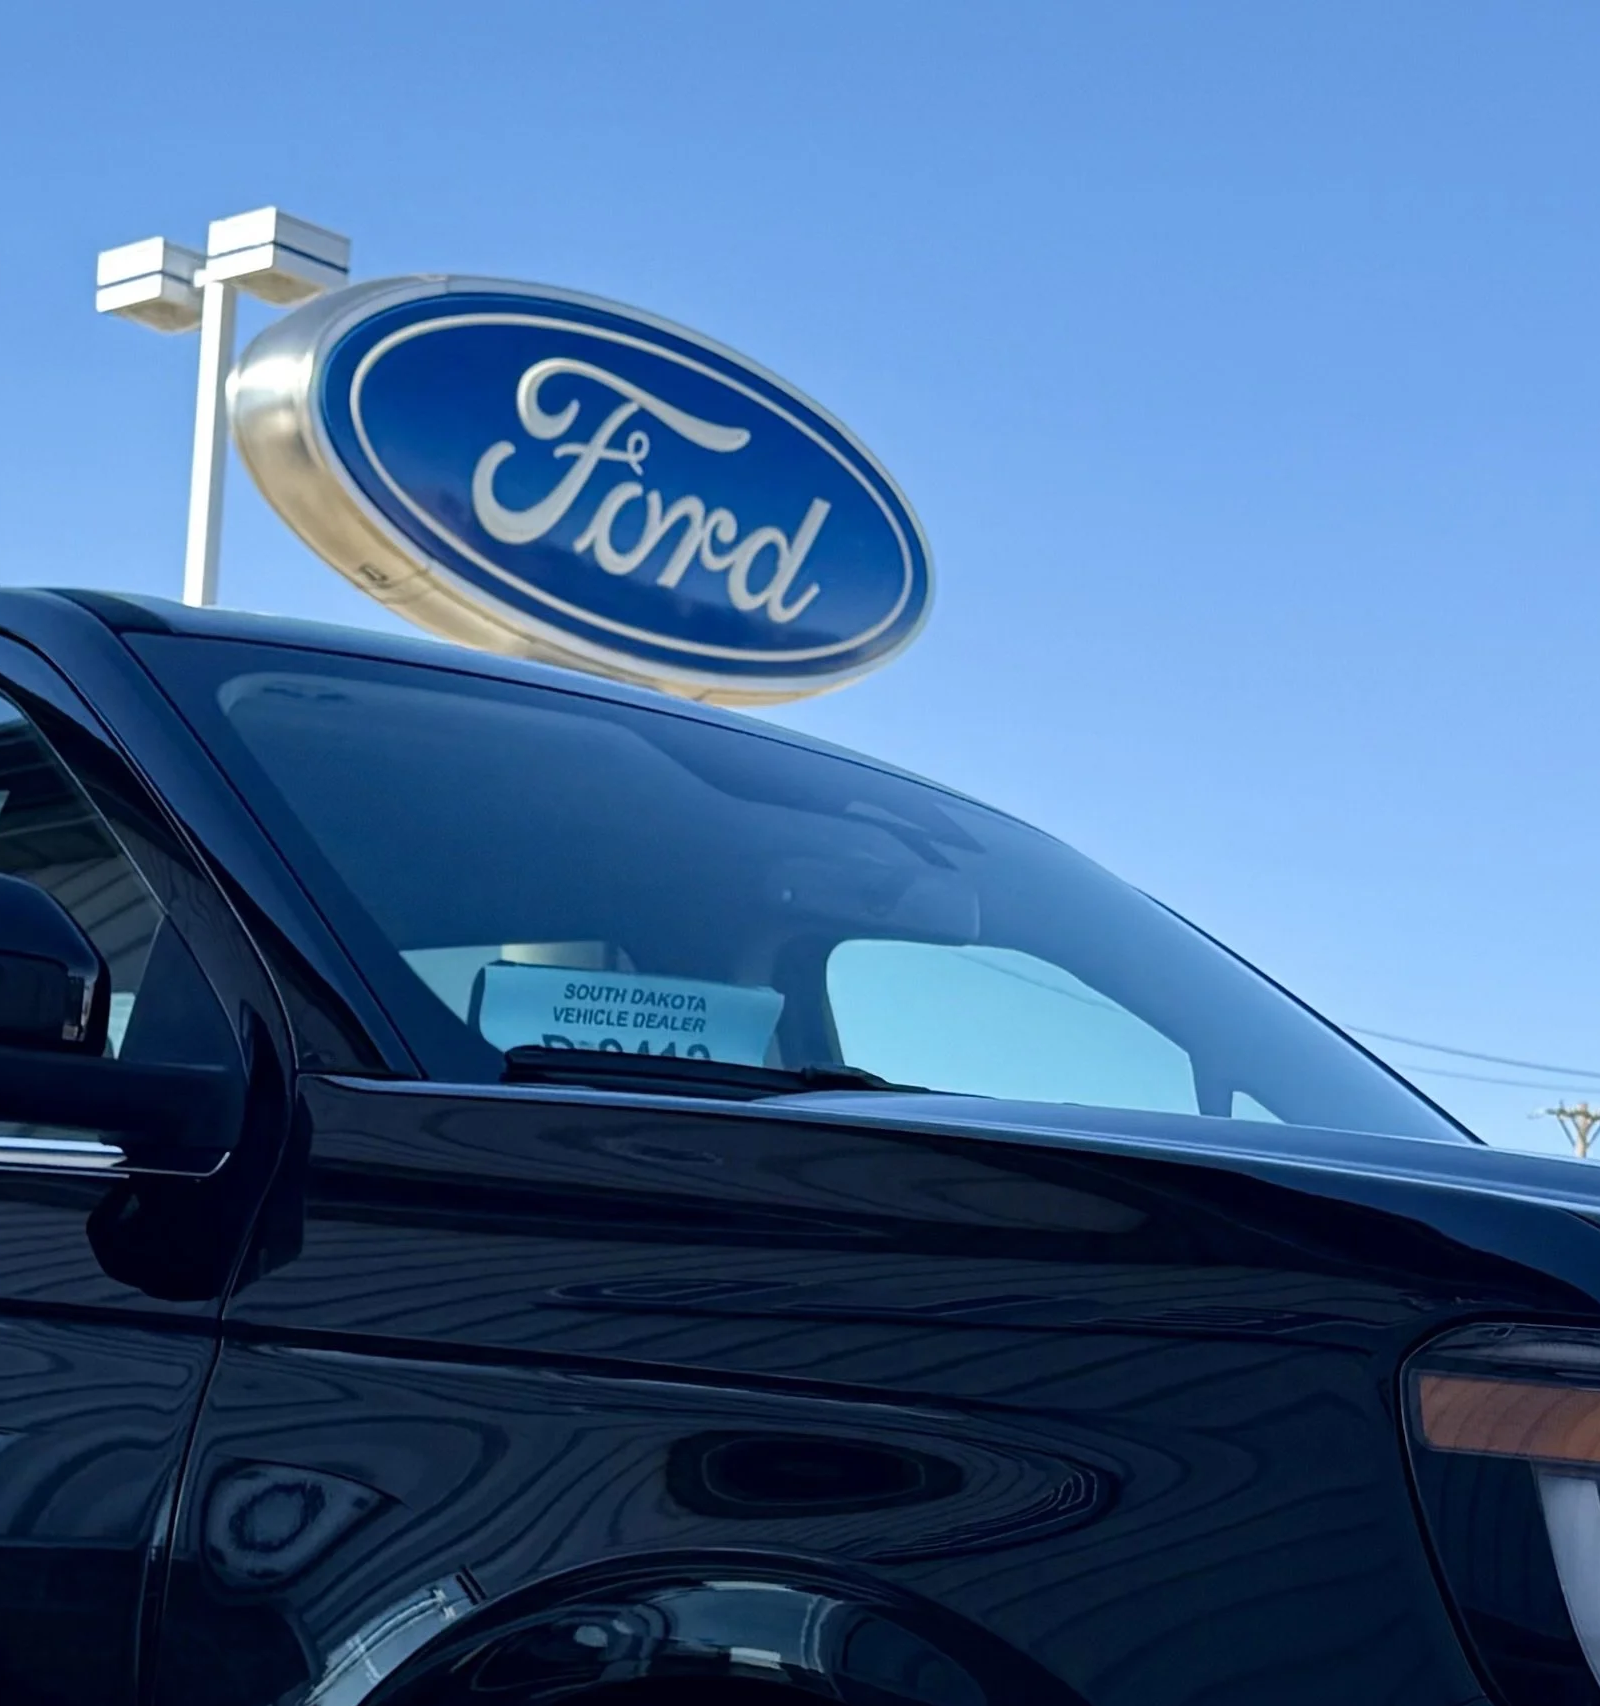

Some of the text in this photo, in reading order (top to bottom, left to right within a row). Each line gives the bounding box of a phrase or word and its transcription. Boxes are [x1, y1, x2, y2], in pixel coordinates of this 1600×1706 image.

[472, 357, 831, 623] Ford
[563, 982, 707, 1013] SOUTH DAKOTA
[553, 1005, 707, 1033] VEHICLE DEALER
